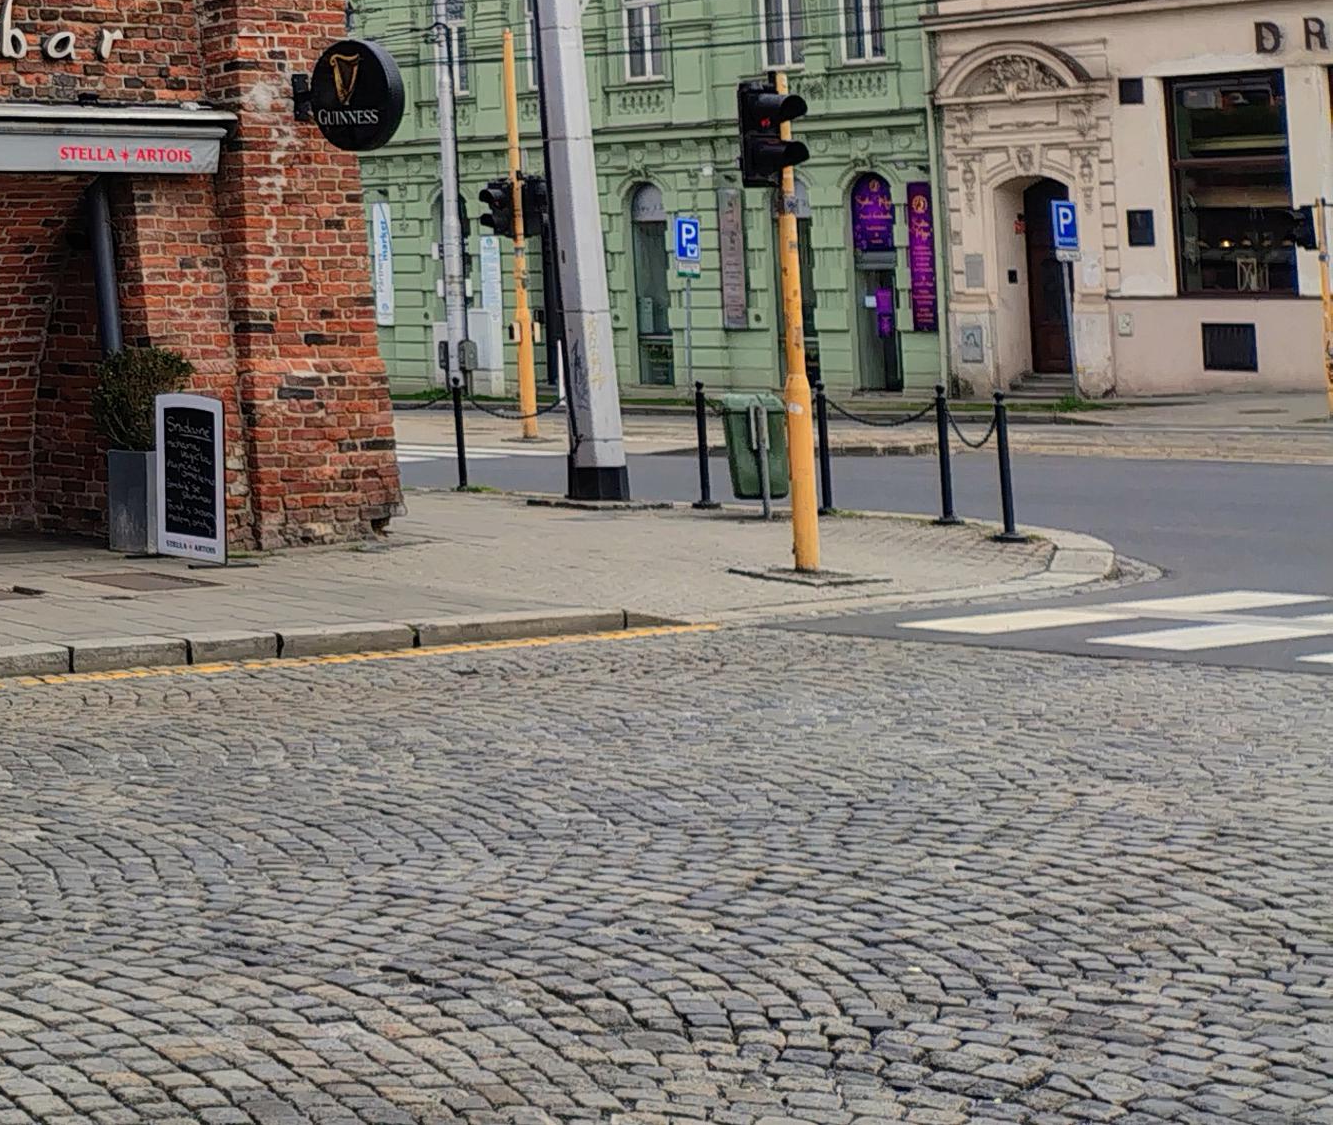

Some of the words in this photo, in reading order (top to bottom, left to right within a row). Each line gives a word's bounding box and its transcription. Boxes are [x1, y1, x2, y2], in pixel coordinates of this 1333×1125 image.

[317, 108, 380, 126] GUINNESS
[59, 145, 117, 162] STELLA
[135, 147, 193, 164] ARTOIS
[1058, 206, 1073, 235] P
[681, 222, 696, 248] P
